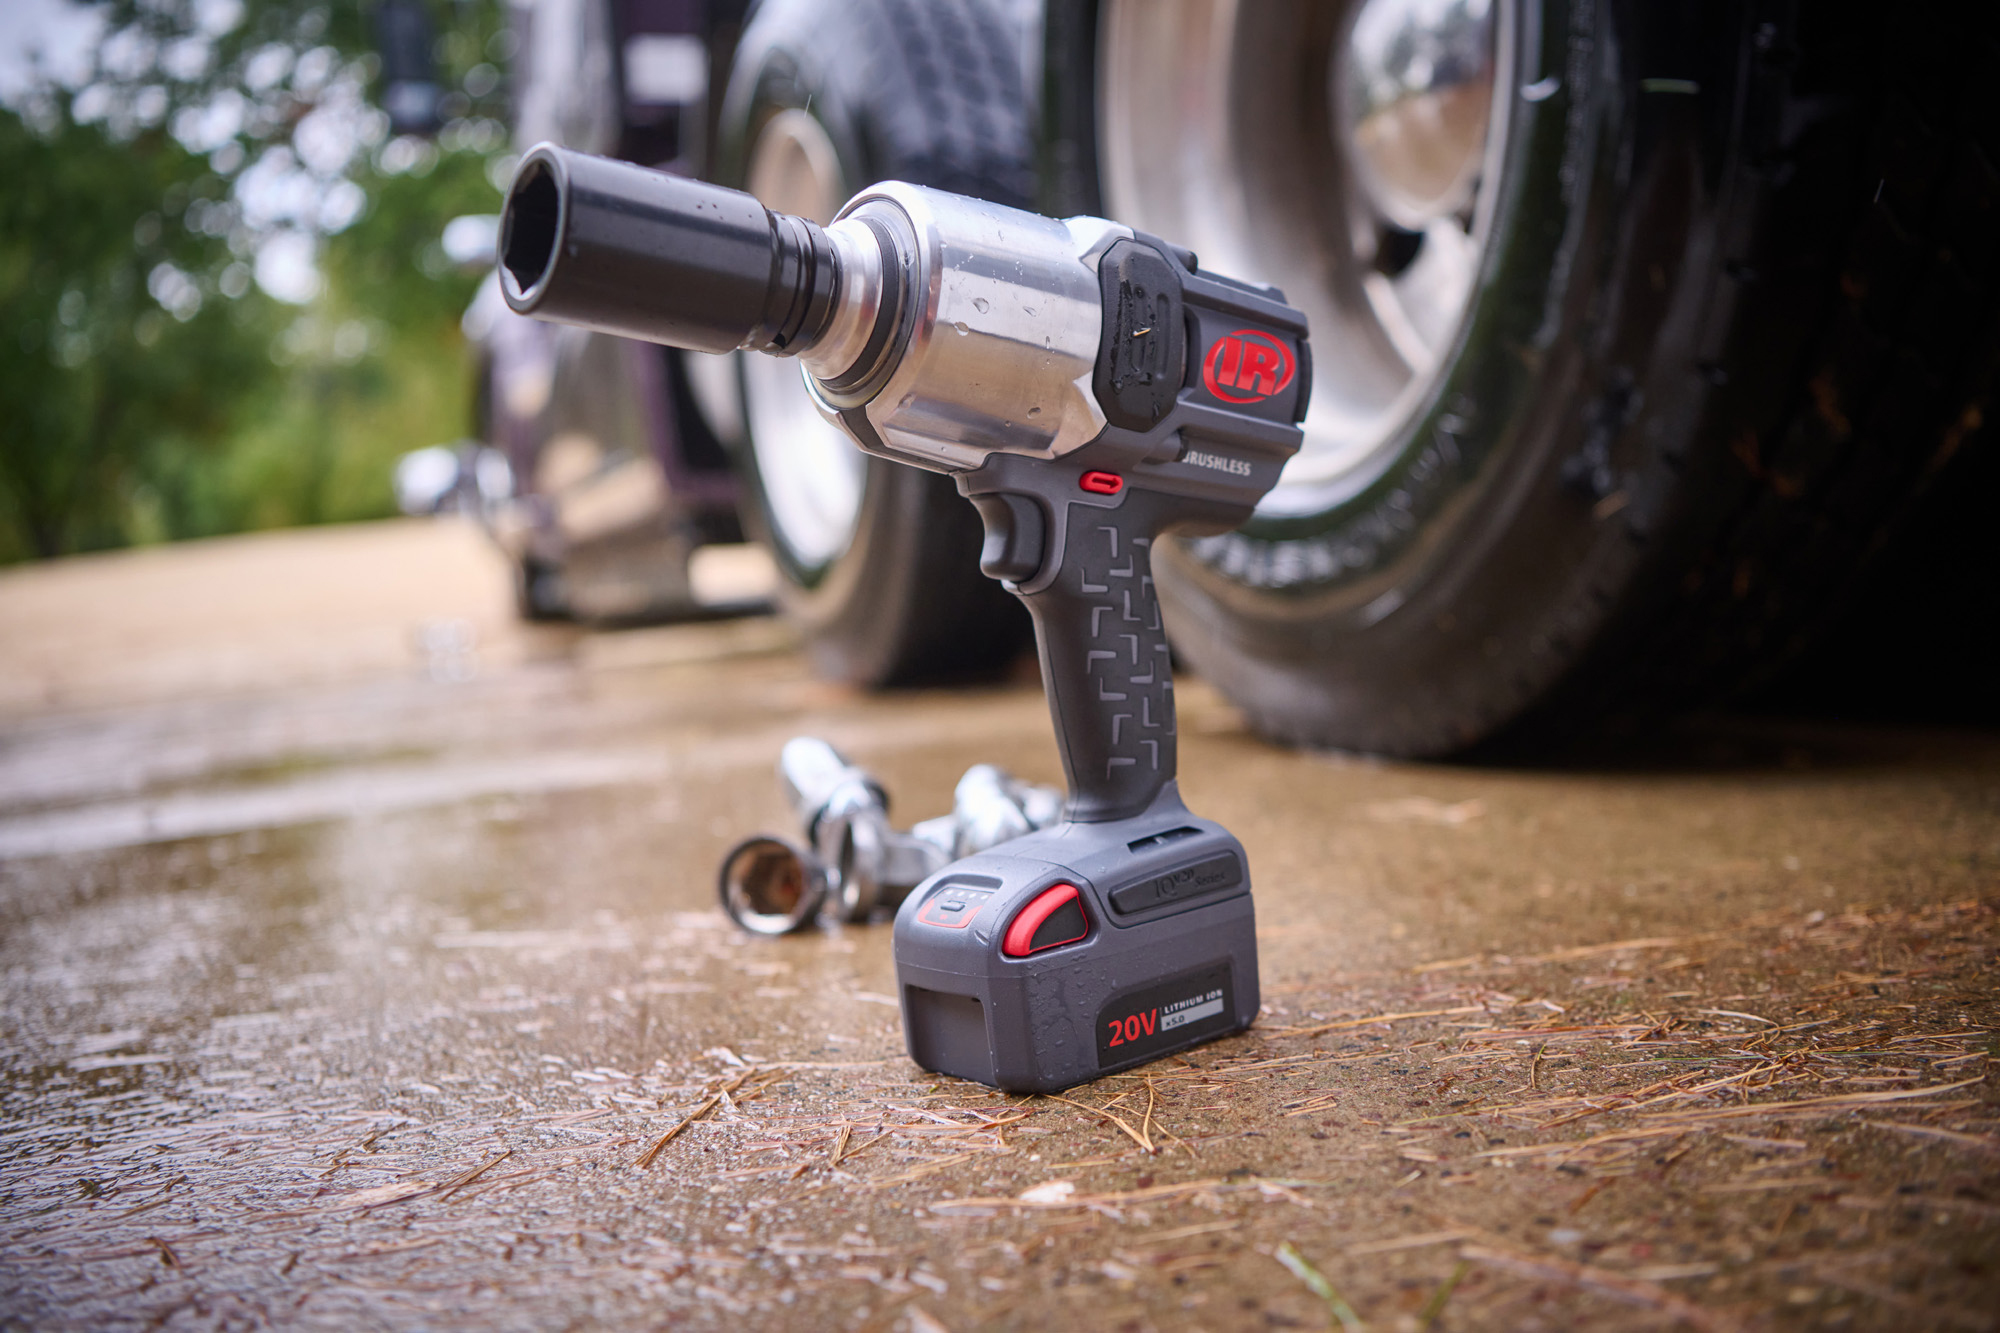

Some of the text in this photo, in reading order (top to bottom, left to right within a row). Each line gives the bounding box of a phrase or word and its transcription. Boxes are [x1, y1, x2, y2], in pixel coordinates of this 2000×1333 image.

[1217, 336, 1281, 396] IR
[1195, 871, 1226, 888] Series
[1164, 988, 1223, 1014] LITHIUM ION
[1108, 1008, 1157, 1047] 20V
